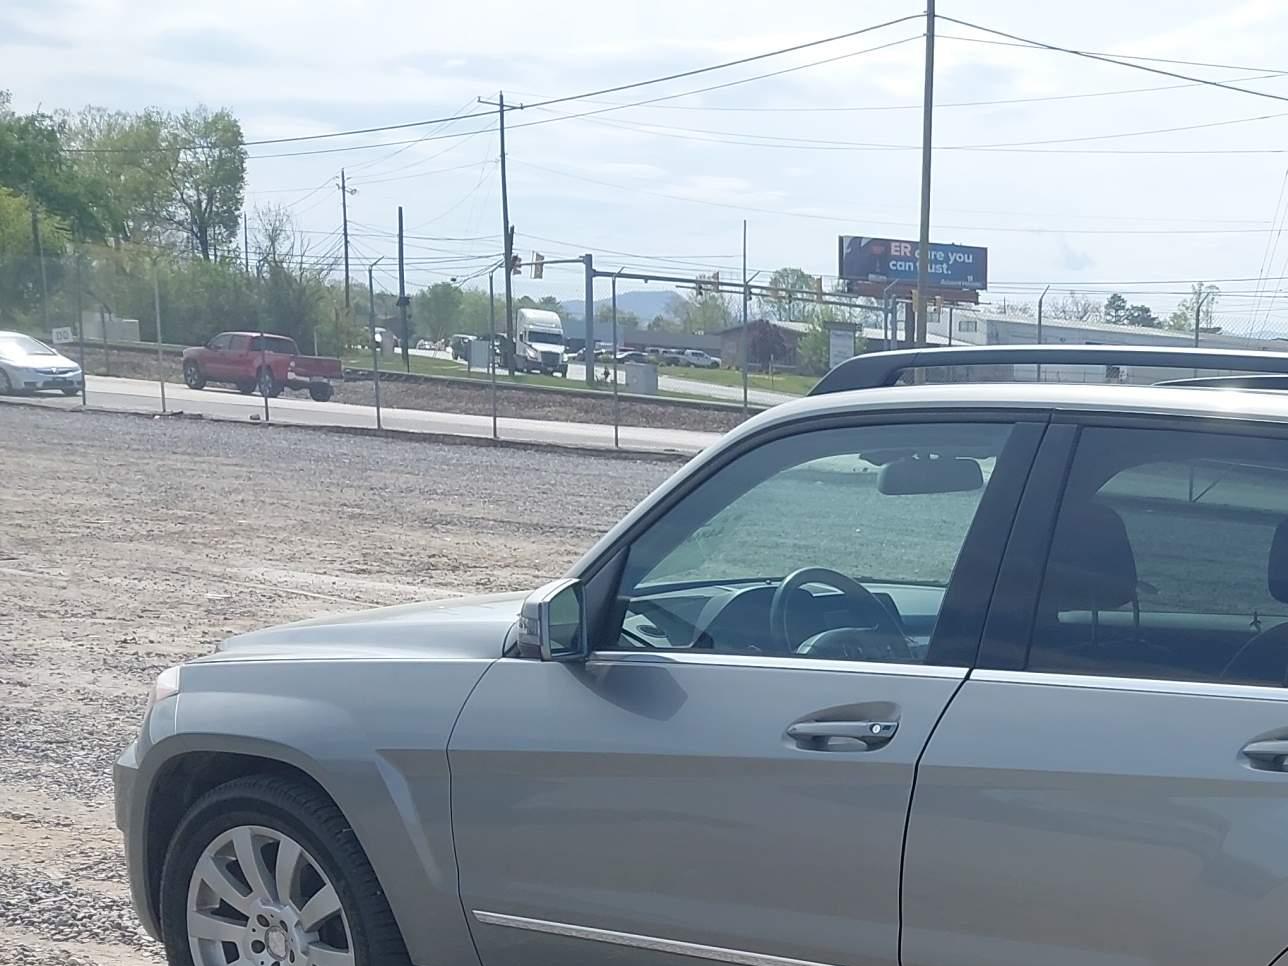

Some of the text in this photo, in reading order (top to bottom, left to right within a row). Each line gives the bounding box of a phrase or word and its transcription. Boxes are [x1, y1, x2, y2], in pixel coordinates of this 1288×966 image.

[891, 242, 973, 264] ER cre you
[889, 260, 914, 271] can
